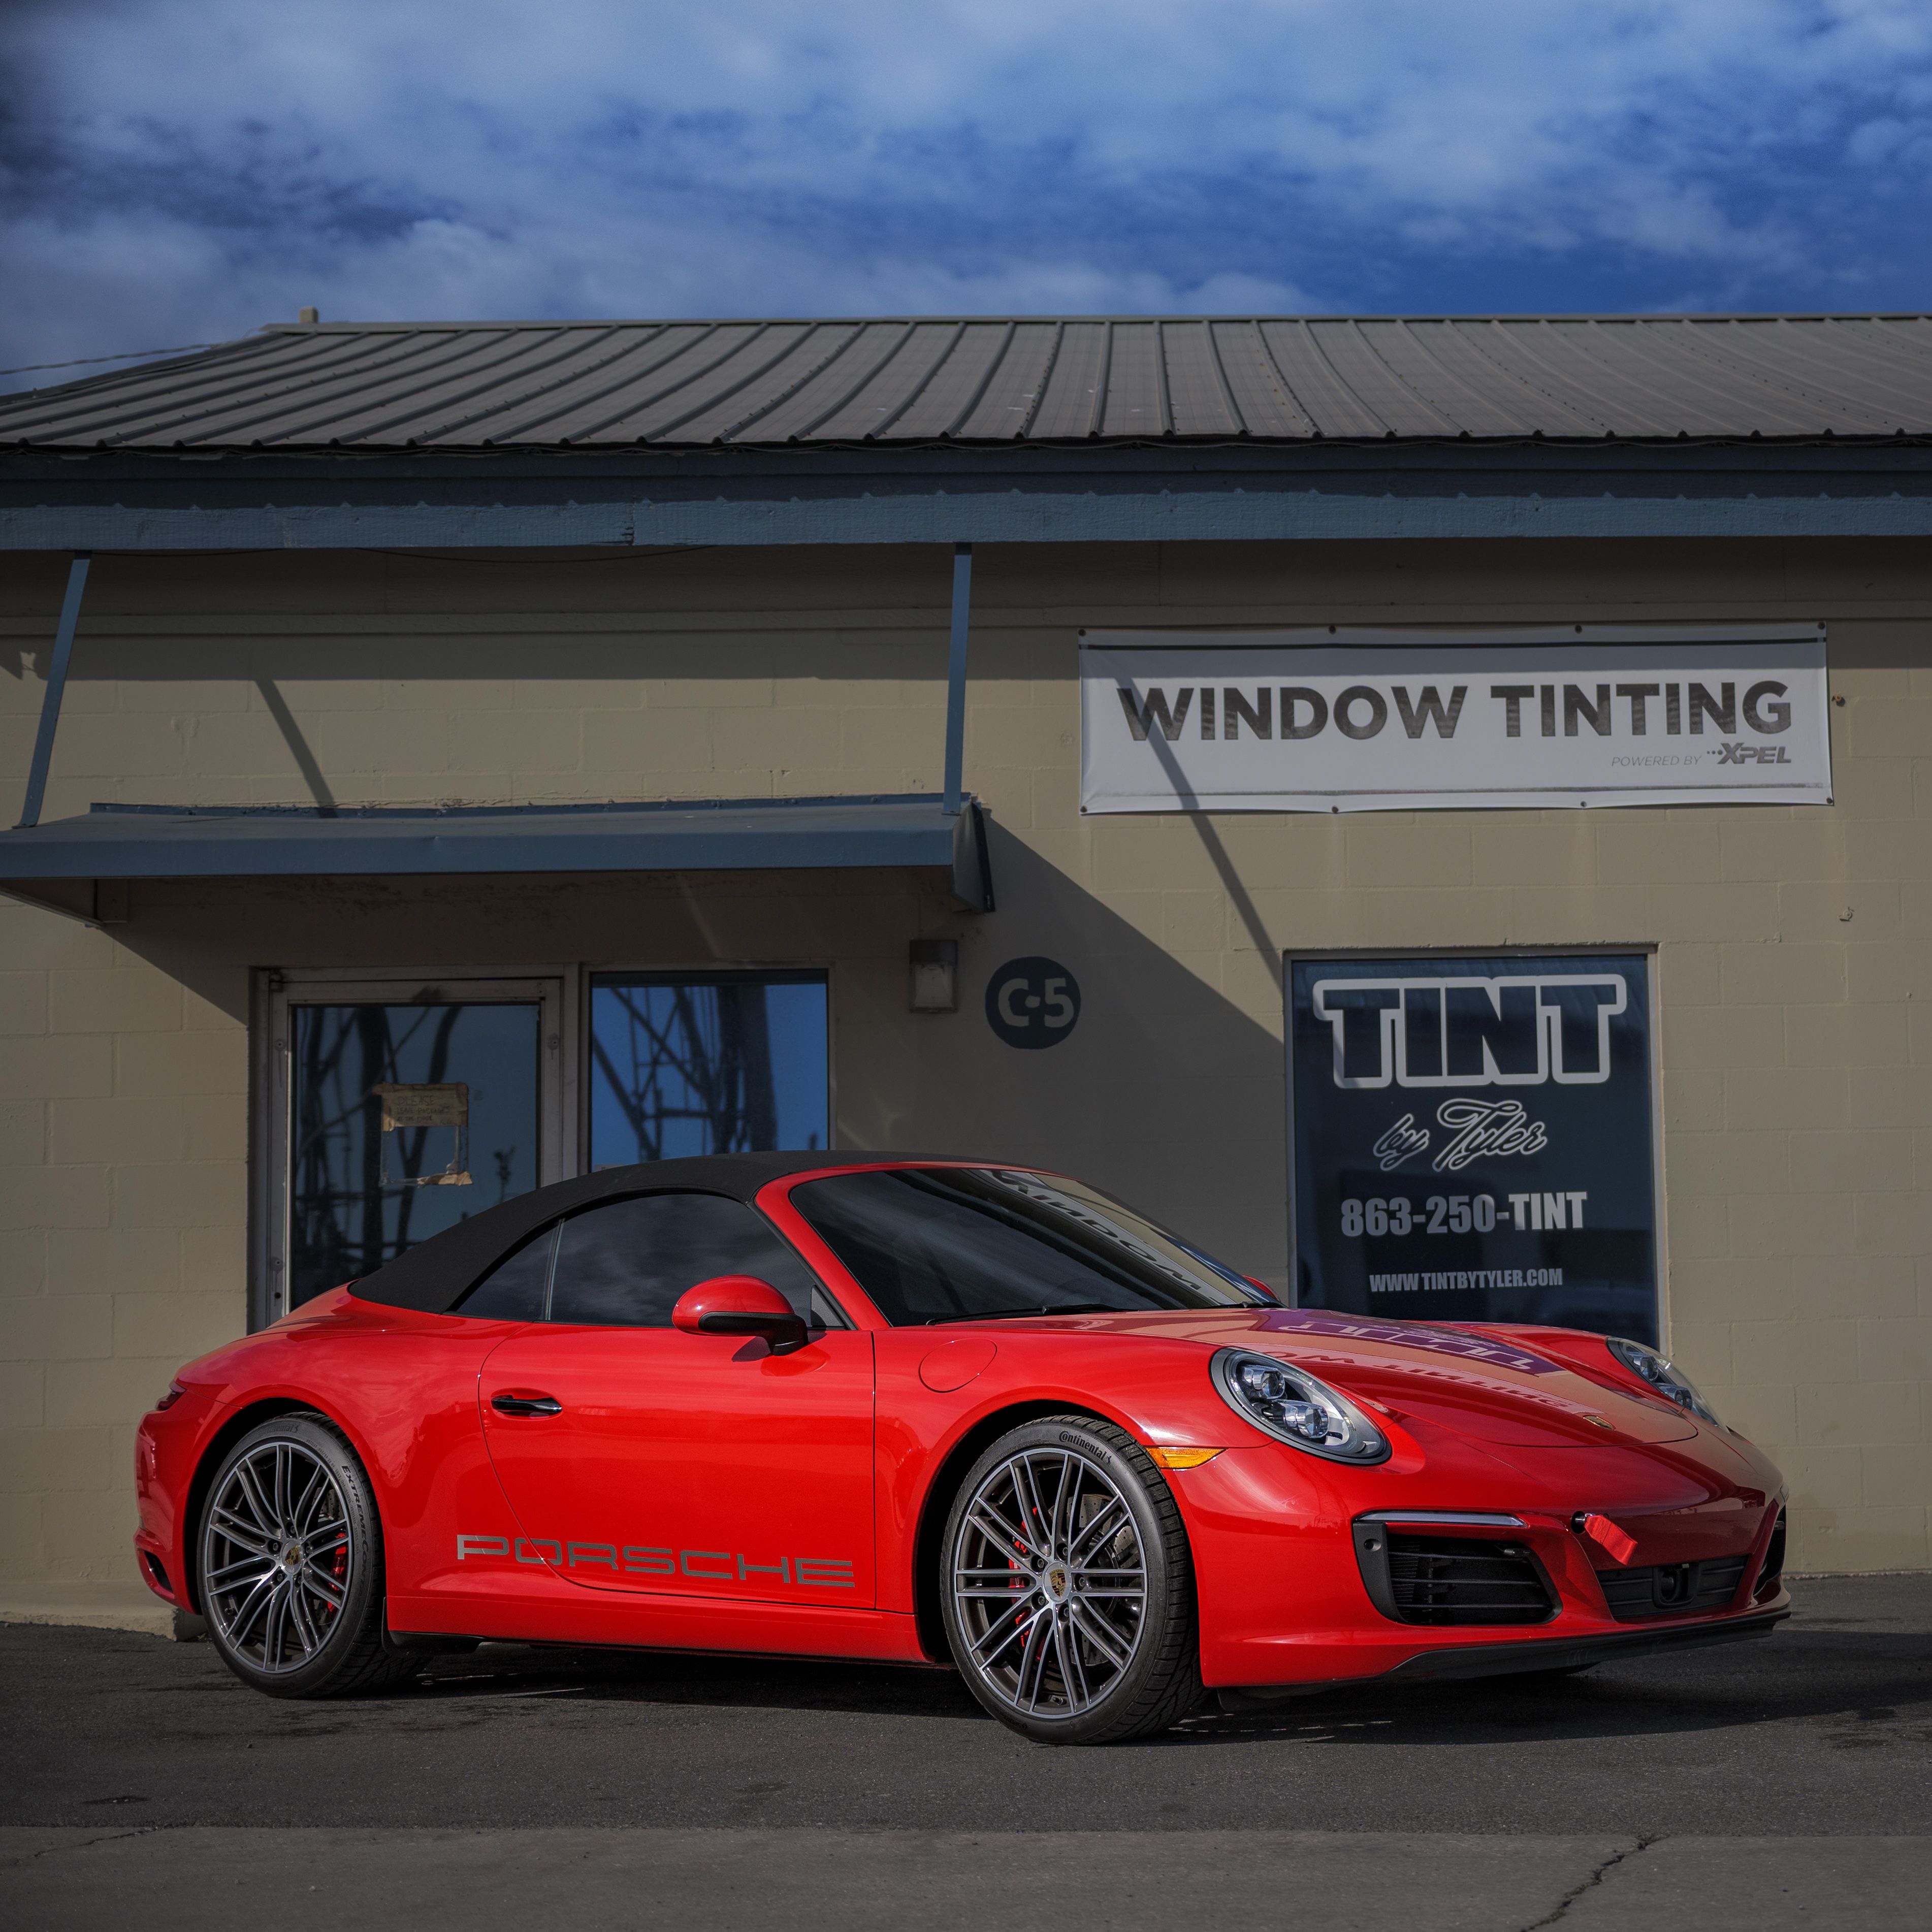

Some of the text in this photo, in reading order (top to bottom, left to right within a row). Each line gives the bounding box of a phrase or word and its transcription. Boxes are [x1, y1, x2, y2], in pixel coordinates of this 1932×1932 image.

[1117, 680, 1792, 741] WINDOW TINTING
[1611, 742, 1792, 767] POWERED BY XPEL
[997, 977, 1074, 1028] C-5
[1312, 974, 1627, 1088] TINT
[1373, 1098, 1548, 1172] by Tyler
[1341, 1192, 1587, 1237] 863-250-TINT
[1059, 1430, 1107, 1460] Continental
[457, 1534, 855, 1588] PORSCHE
